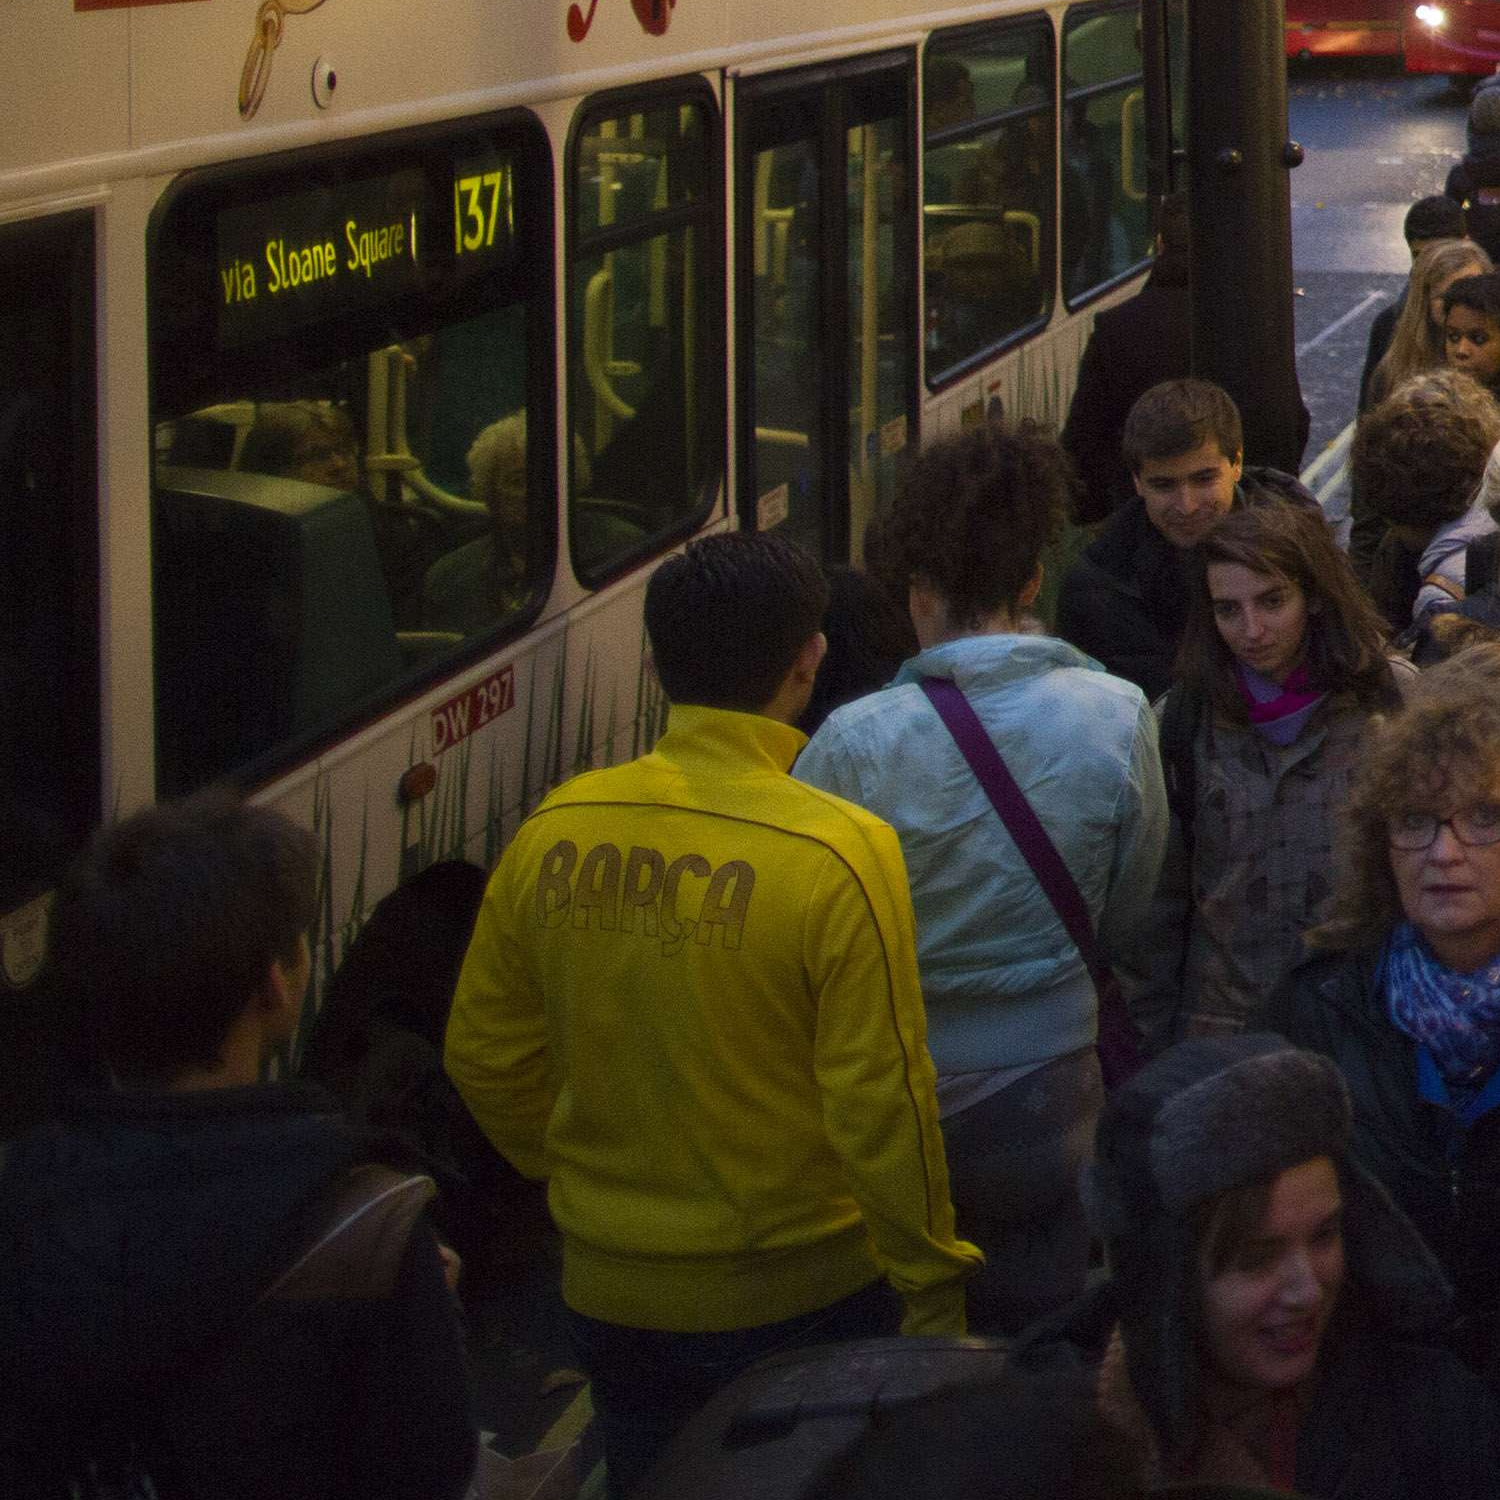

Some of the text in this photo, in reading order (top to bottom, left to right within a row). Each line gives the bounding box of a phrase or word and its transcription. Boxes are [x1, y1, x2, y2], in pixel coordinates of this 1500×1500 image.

[221, 220, 404, 304] via Sloane Square
[432, 670, 514, 752] DW 297
[534, 838, 756, 957] BARÇA
